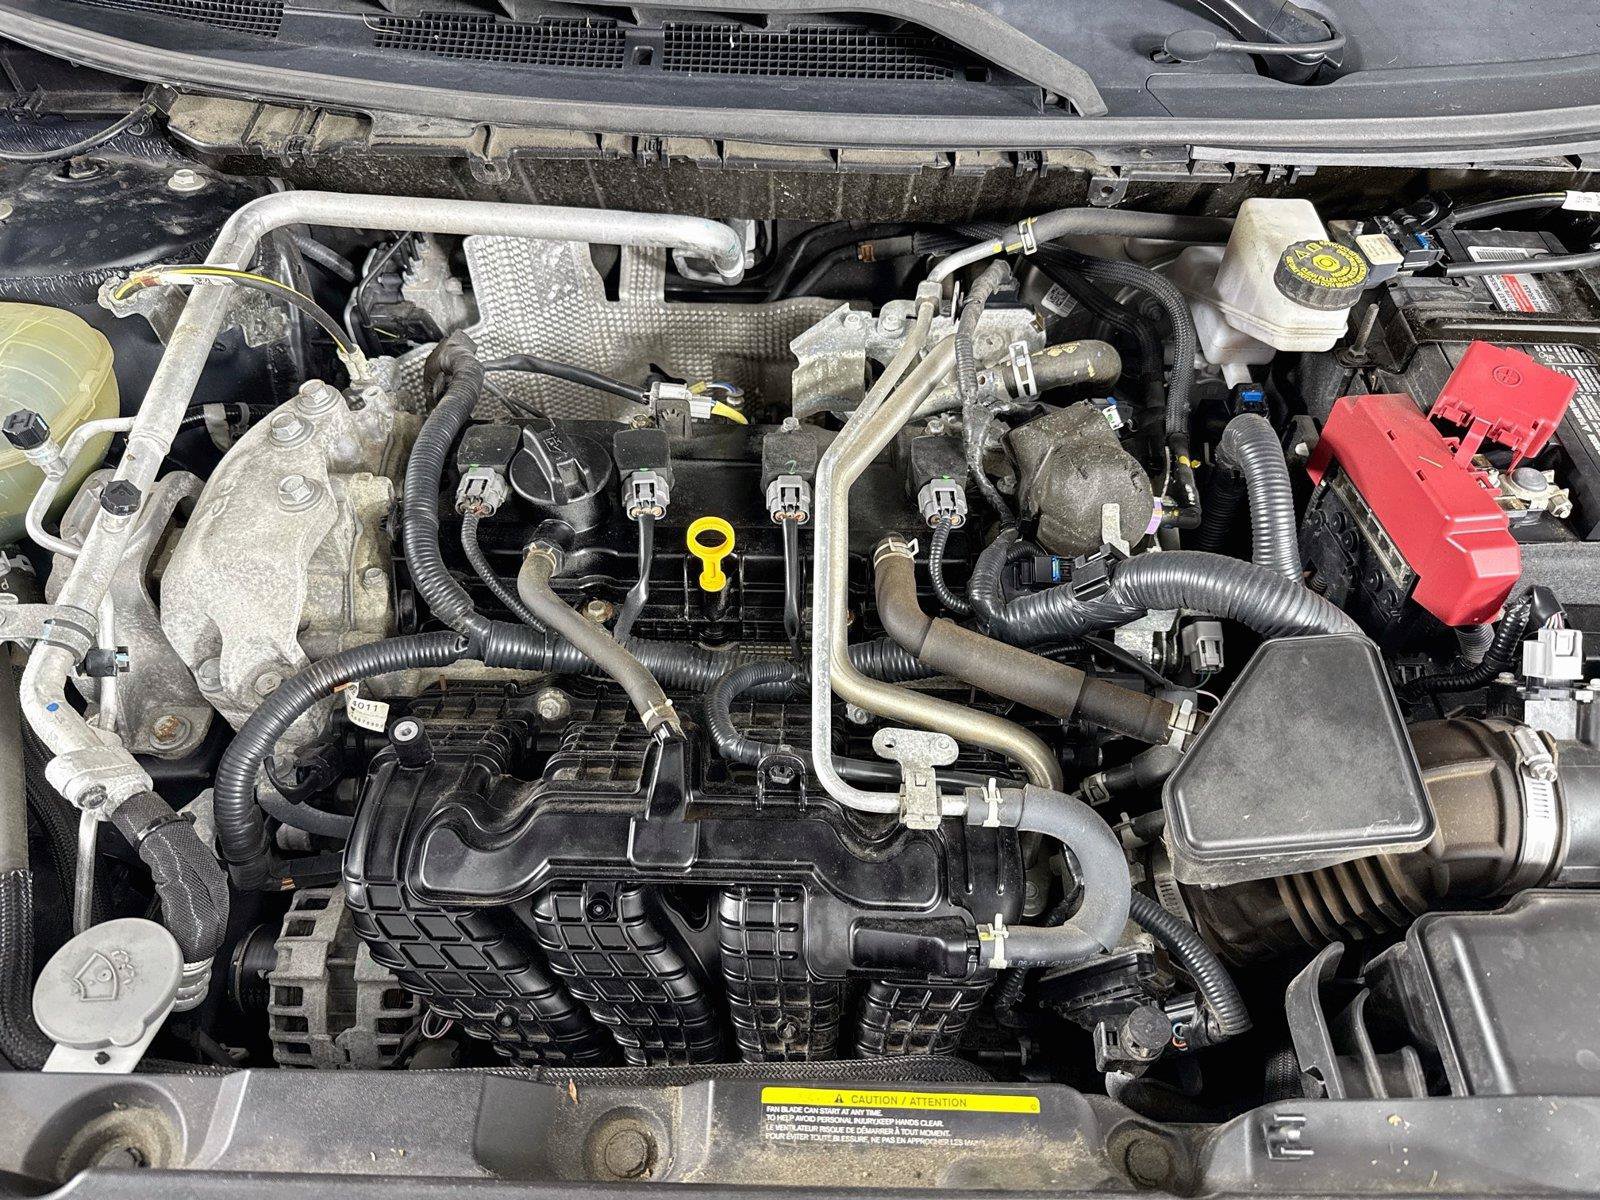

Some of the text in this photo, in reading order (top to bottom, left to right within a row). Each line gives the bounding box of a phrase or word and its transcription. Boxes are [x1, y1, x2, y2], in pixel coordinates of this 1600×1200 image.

[851, 1095, 967, 1107] CAUTION / ATTENTION
[819, 1107, 841, 1115] START
[816, 1116, 853, 1124] PERSONAL
[895, 1118, 919, 1126] HANDS
[920, 1119, 944, 1127] CLEAR.
[774, 1124, 818, 1132] VENTILATEUR
[819, 1125, 845, 1133] RISQUE
[920, 1129, 951, 1137] MOMENT.
[765, 1132, 785, 1140] POUR
[870, 1136, 881, 1144] NE
[950, 1138, 964, 1146] LES
